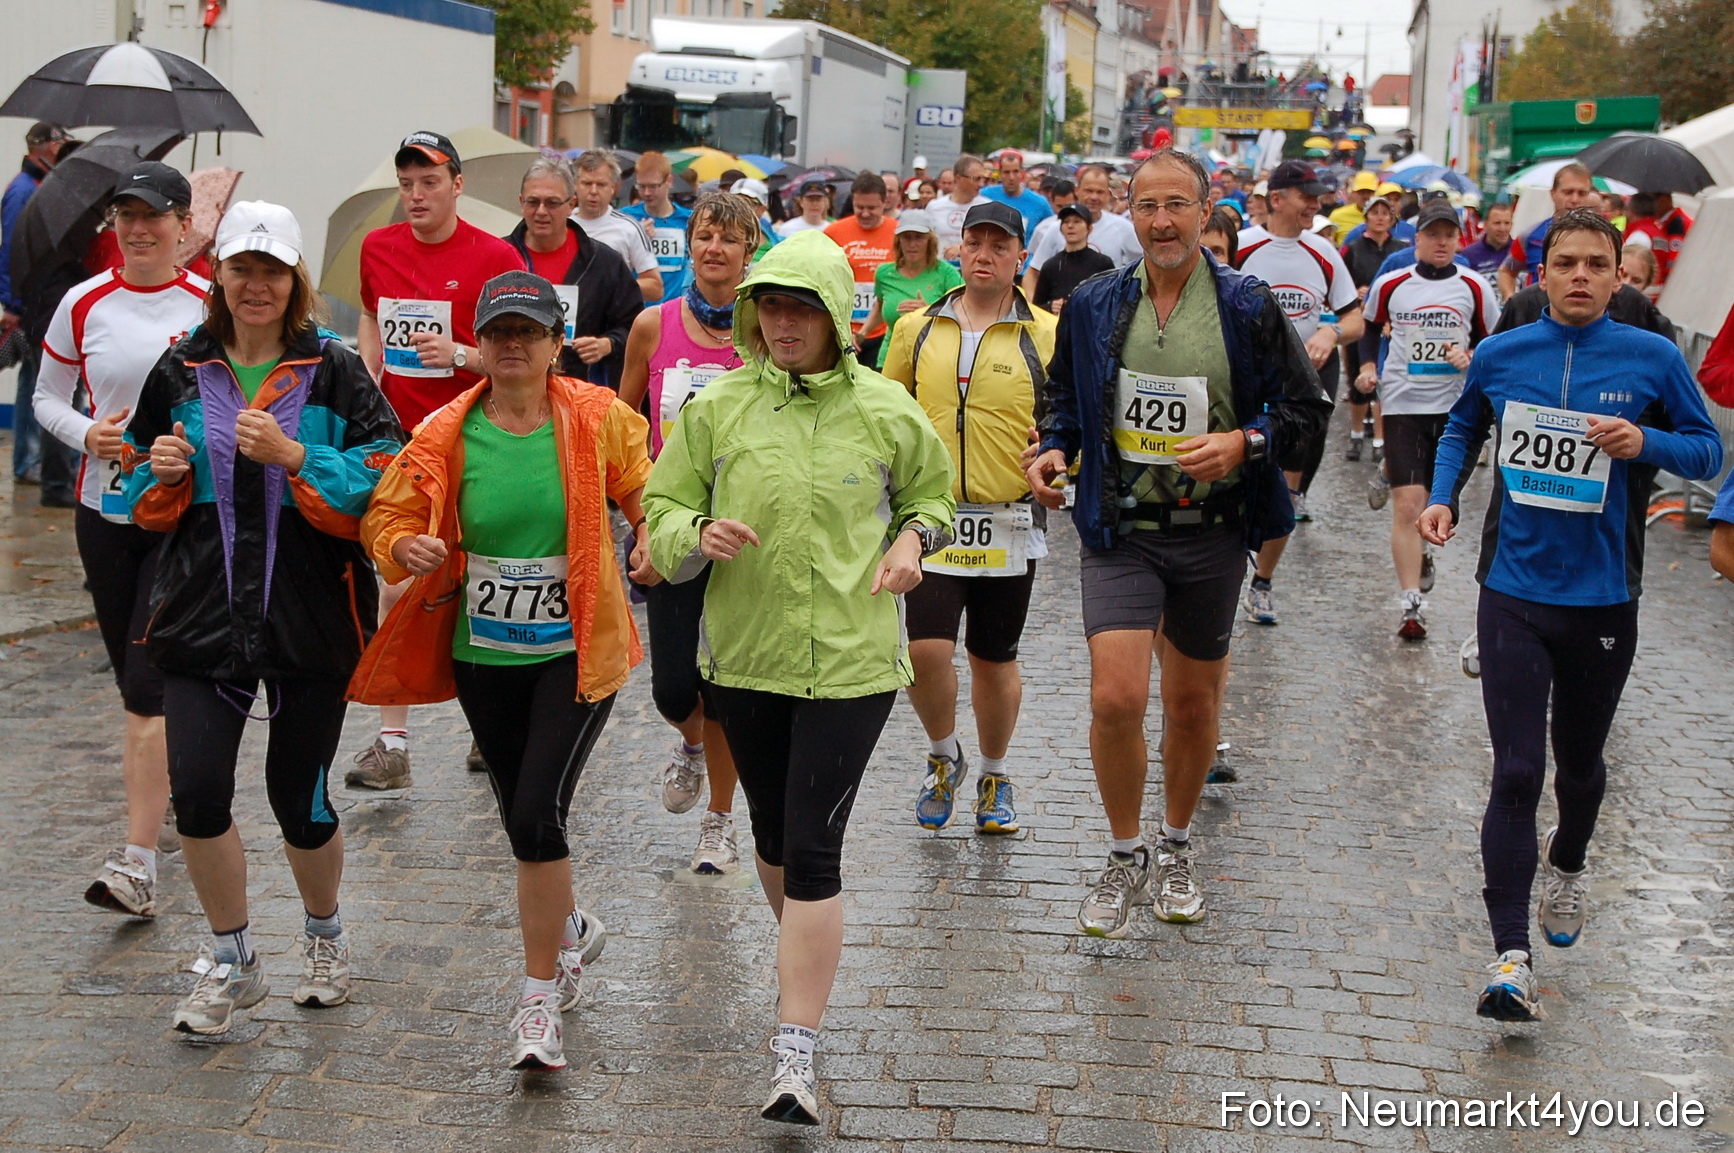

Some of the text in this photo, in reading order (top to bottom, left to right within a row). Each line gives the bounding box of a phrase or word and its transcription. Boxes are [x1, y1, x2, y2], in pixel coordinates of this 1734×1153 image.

[665, 67, 738, 86] BOCK
[1216, 112, 1264, 125] START
[854, 293, 877, 309] 31
[1271, 292, 1304, 302] HART
[1281, 301, 1310, 311] ANIG
[1396, 312, 1451, 321] GERHART
[400, 353, 422, 366] Geor
[993, 363, 1013, 372] GORE
[1136, 380, 1177, 392] BOCK
[1125, 397, 1187, 433] 429
[1536, 412, 1581, 428] BOCK
[1140, 437, 1167, 452] Kurt
[1508, 430, 1602, 475] 2987
[1521, 475, 1574, 497] Bastian
[945, 552, 987, 565] Norbert
[499, 564, 544, 576] BOCK
[478, 580, 569, 620] 2773
[507, 627, 537, 642] Rita
[780, 1027, 796, 1036] TECH
